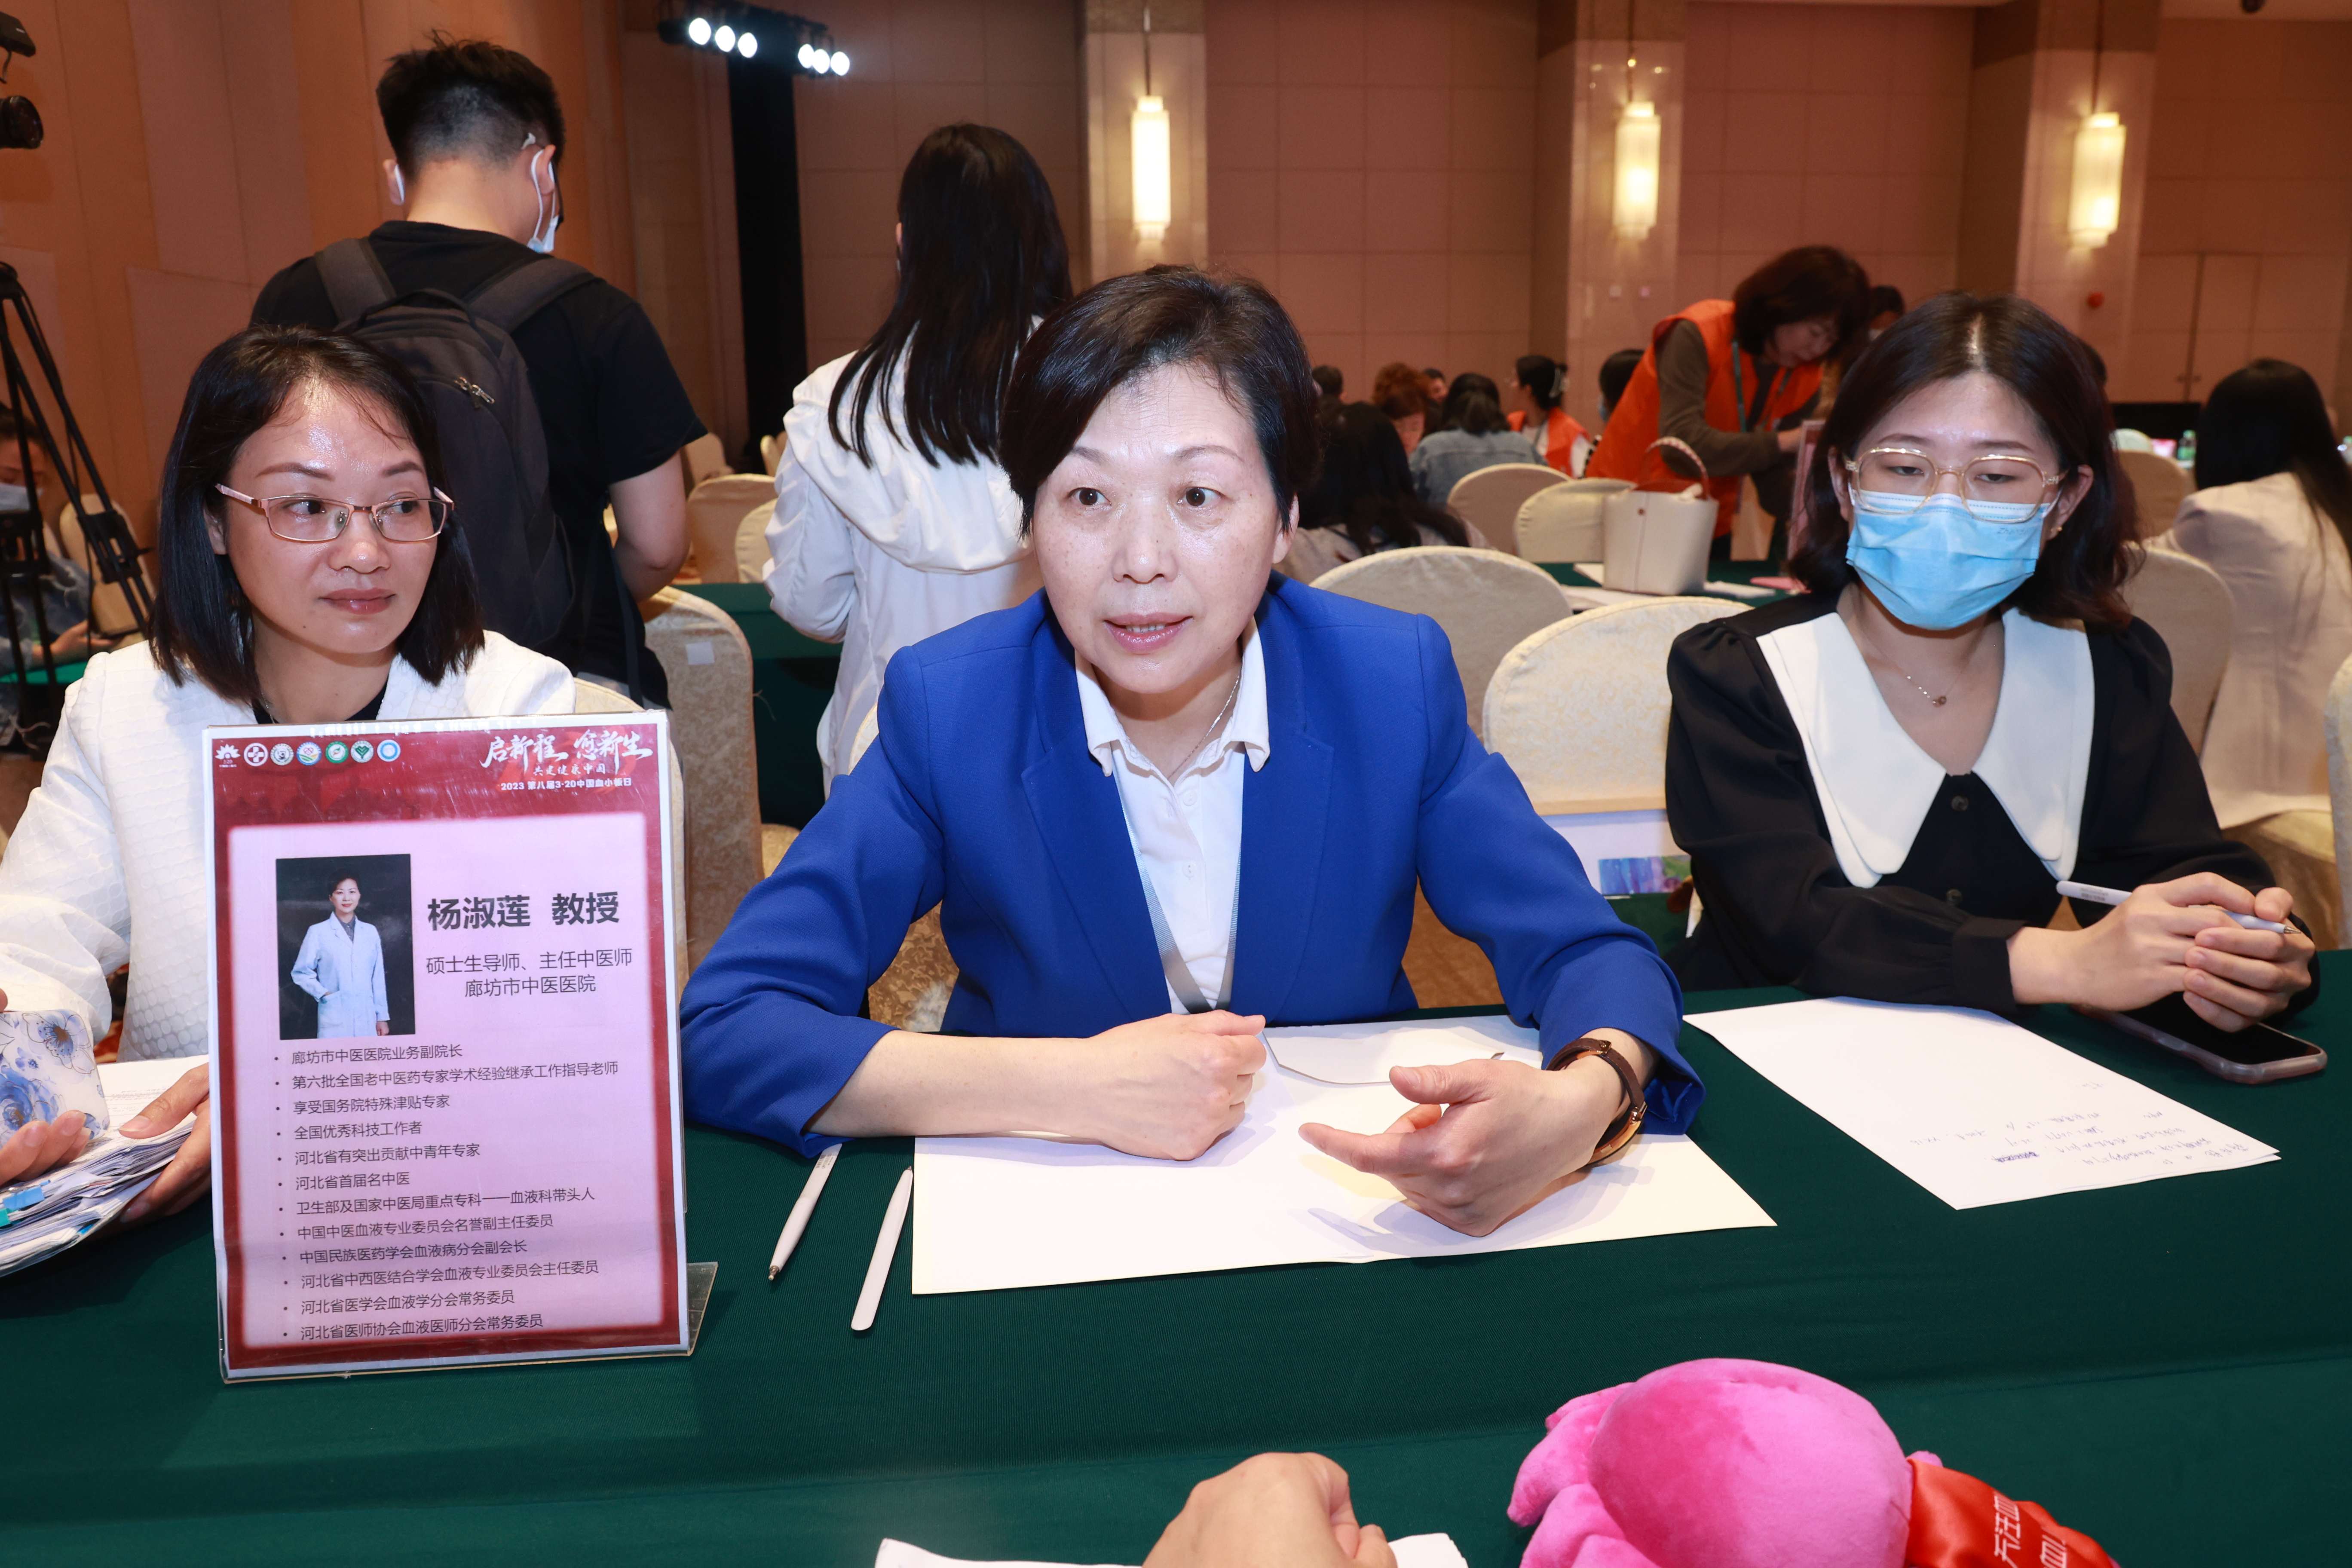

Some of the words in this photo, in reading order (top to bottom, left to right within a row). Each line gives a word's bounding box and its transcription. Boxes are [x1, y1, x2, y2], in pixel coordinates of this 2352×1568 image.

[501, 782, 525, 791] 2023
[427, 894, 531, 931] 杨淑莲
[551, 891, 620, 925] 教授
[426, 948, 633, 975] 硕士生导师、主任中医师
[465, 974, 596, 998] 廊坊市中医医院
[292, 1044, 462, 1064] 廊坊市中医医院业务副院长
[292, 1061, 618, 1089] 第六批全国老中医药专家学术经验继承工作指导老师
[293, 1094, 450, 1115] 享受国务院特殊津贴专家
[294, 1121, 422, 1139] 全国优秀科技工作者
[295, 1143, 480, 1165] 河北省有突出贡献中青年专家
[296, 1172, 410, 1190] 河北省首届名中医
[298, 1214, 553, 1240] 中国中医血液专业委员会名誉副主任委员
[300, 1240, 527, 1264] 中国民族医药学会血液病分会副会长
[301, 1260, 599, 1289] 河北省中西医结合学会血液专业委员会主任委员
[301, 1290, 514, 1314] 河北省医学会血液学分会常务委员
[301, 1314, 543, 1340] 河北省医师协会血液医师分会常务委员
